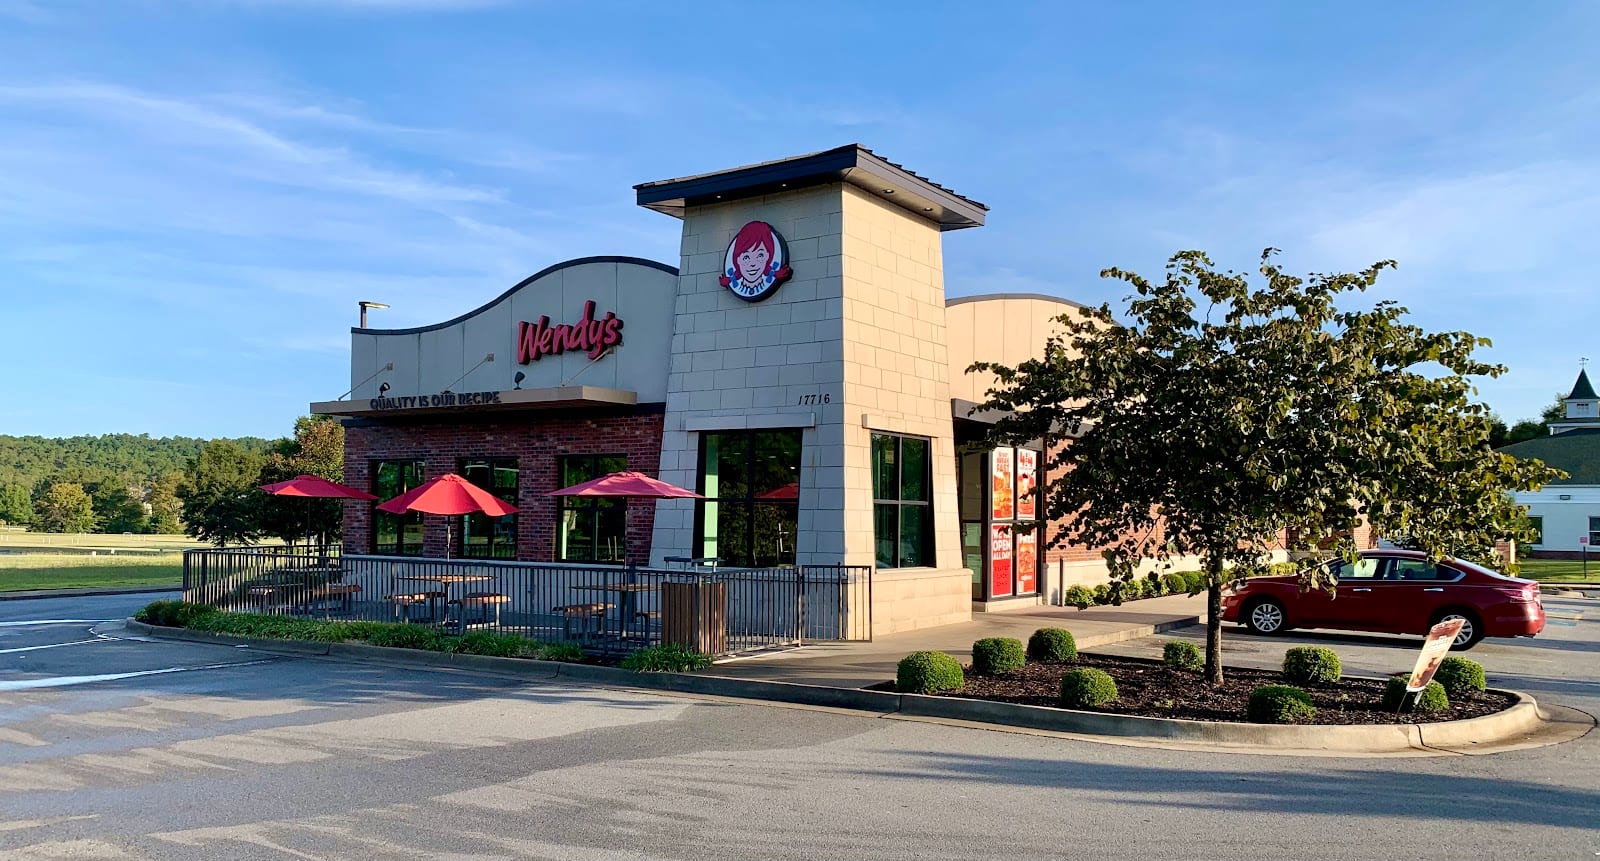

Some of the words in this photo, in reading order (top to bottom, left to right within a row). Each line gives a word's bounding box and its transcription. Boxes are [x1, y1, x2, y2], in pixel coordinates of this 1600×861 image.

[517, 299, 624, 365] Wendy's
[370, 396, 416, 411] QUALITY
[419, 395, 430, 407] IS
[431, 393, 456, 407] OUR
[458, 391, 501, 405] RECIPE
[798, 393, 830, 406] 17716
[993, 539, 1011, 552] OPEN
